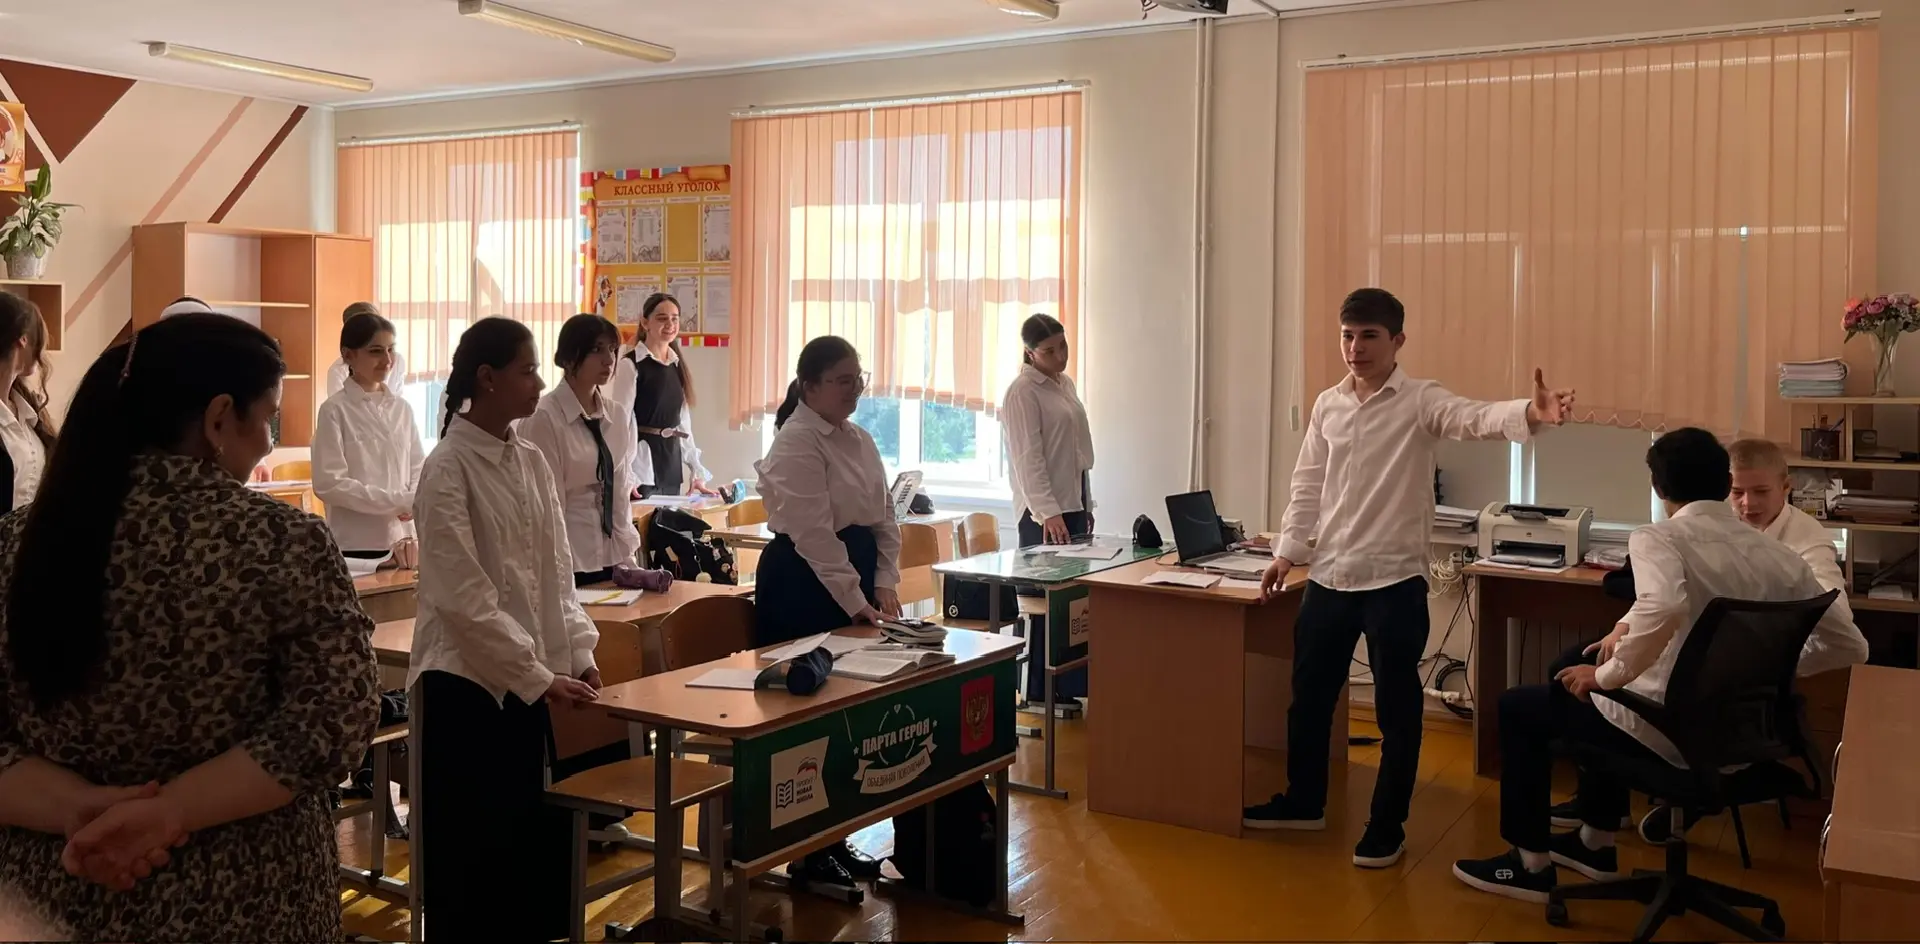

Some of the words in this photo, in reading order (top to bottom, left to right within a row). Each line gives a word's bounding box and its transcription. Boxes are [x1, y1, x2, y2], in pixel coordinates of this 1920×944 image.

[614, 181, 674, 196] КЛАССНЫЙ
[678, 181, 721, 193] УГОЛОК
[862, 731, 897, 757] ПАРТА
[898, 717, 930, 743] ГЕРОЯ
